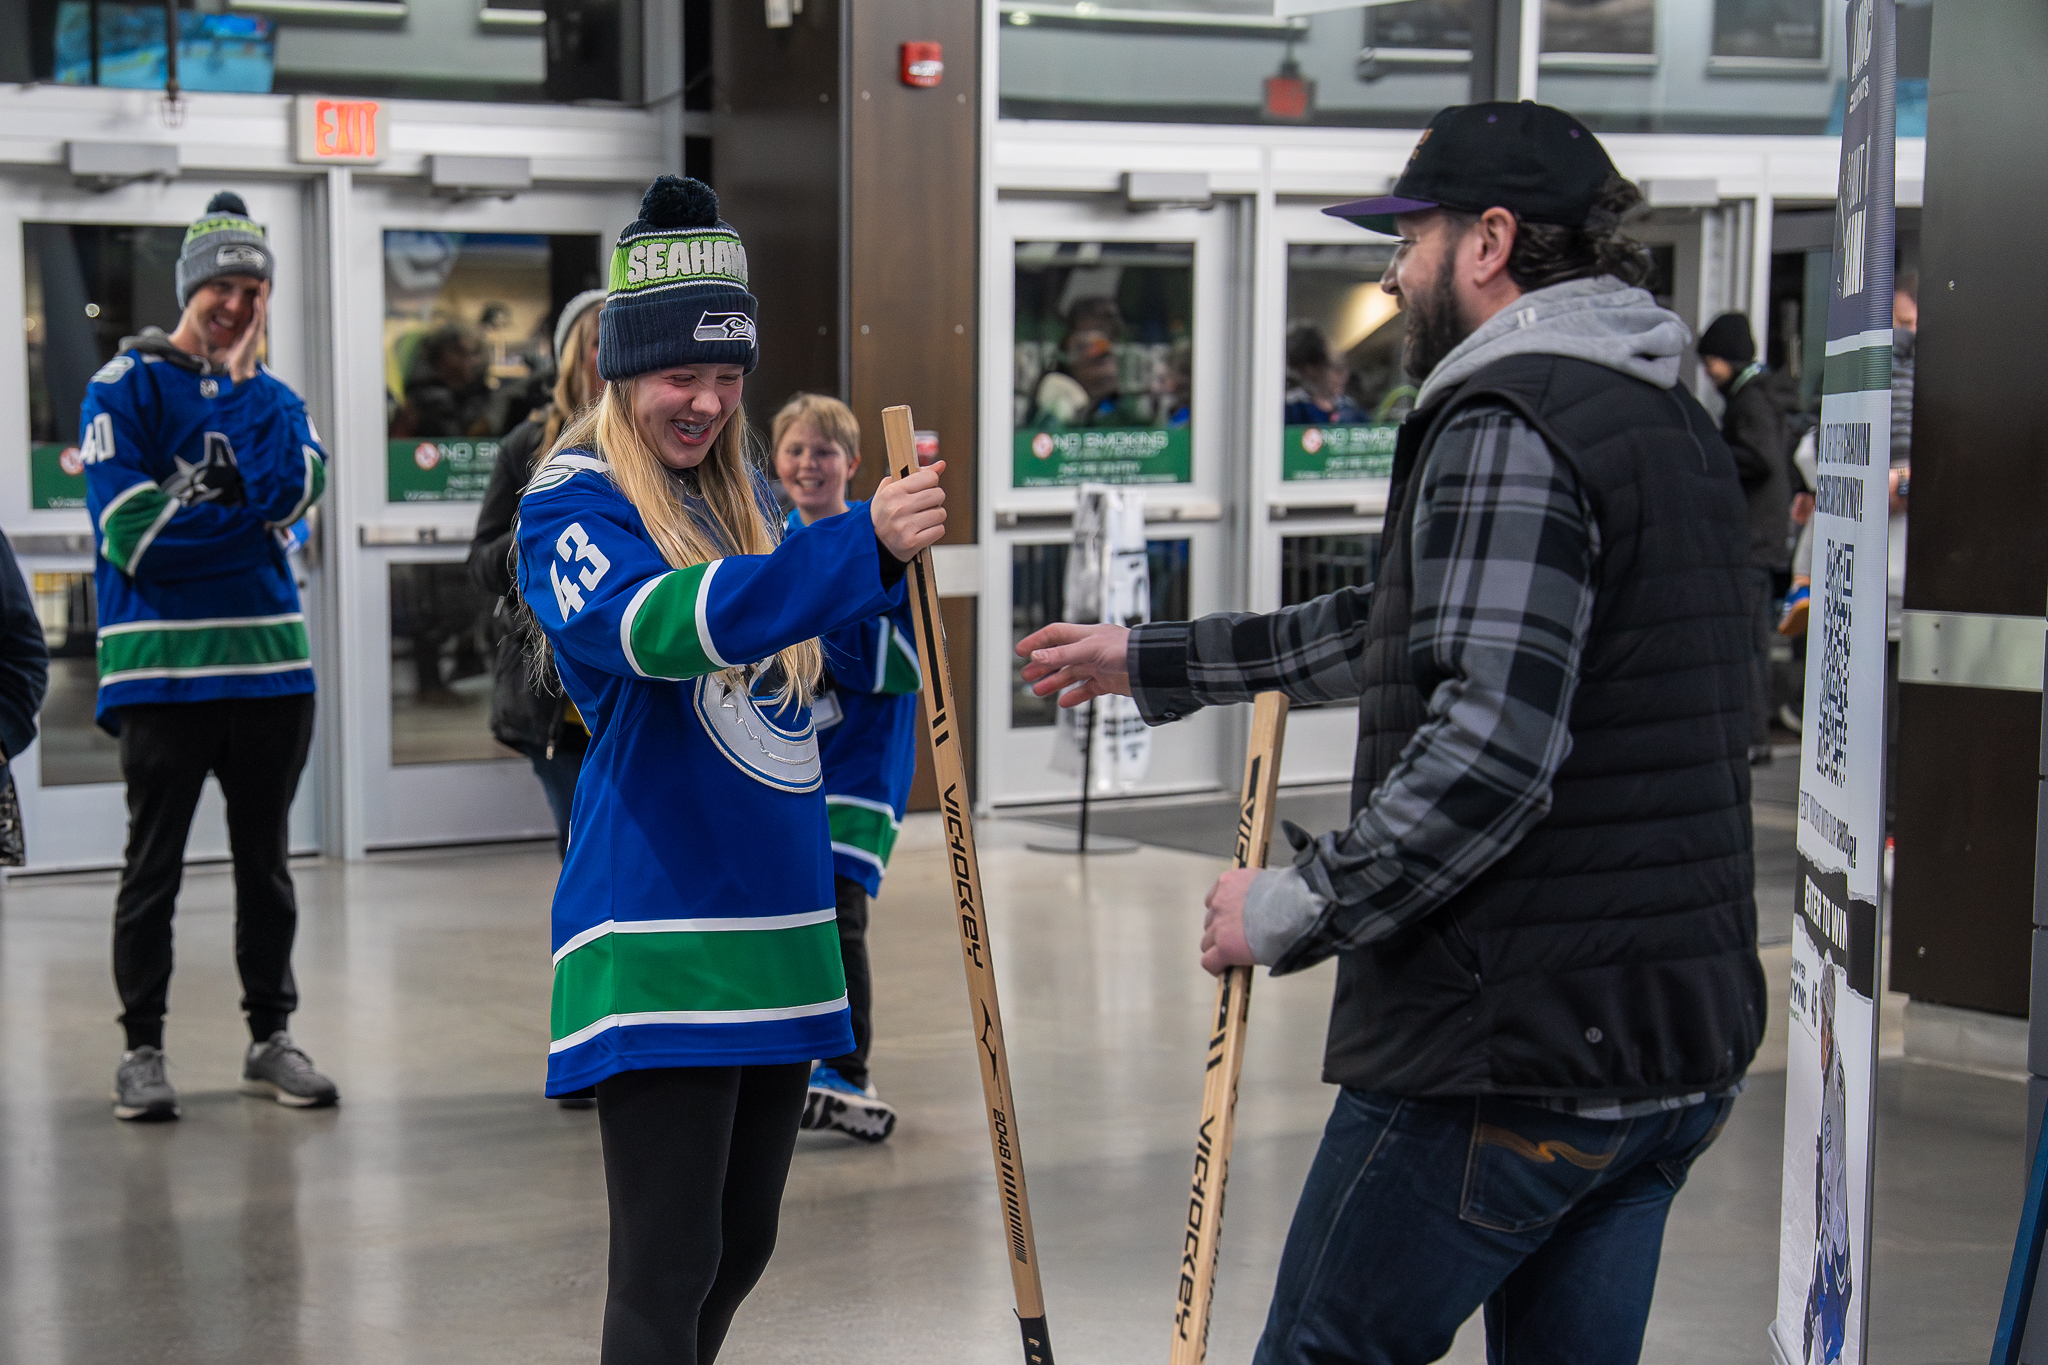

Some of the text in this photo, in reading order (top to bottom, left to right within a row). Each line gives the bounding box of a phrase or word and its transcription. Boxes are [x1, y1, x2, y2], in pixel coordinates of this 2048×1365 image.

[315, 100, 379, 158] EXIT
[80, 412, 115, 465] 40
[1053, 434, 1080, 450] NO
[550, 522, 610, 623] 43
[943, 782, 983, 969] VICHOCKEY
[1822, 893, 1831, 938] TO
[992, 1107, 1012, 1160] 2048
[1174, 1115, 1215, 1342] VICHOCKEY
